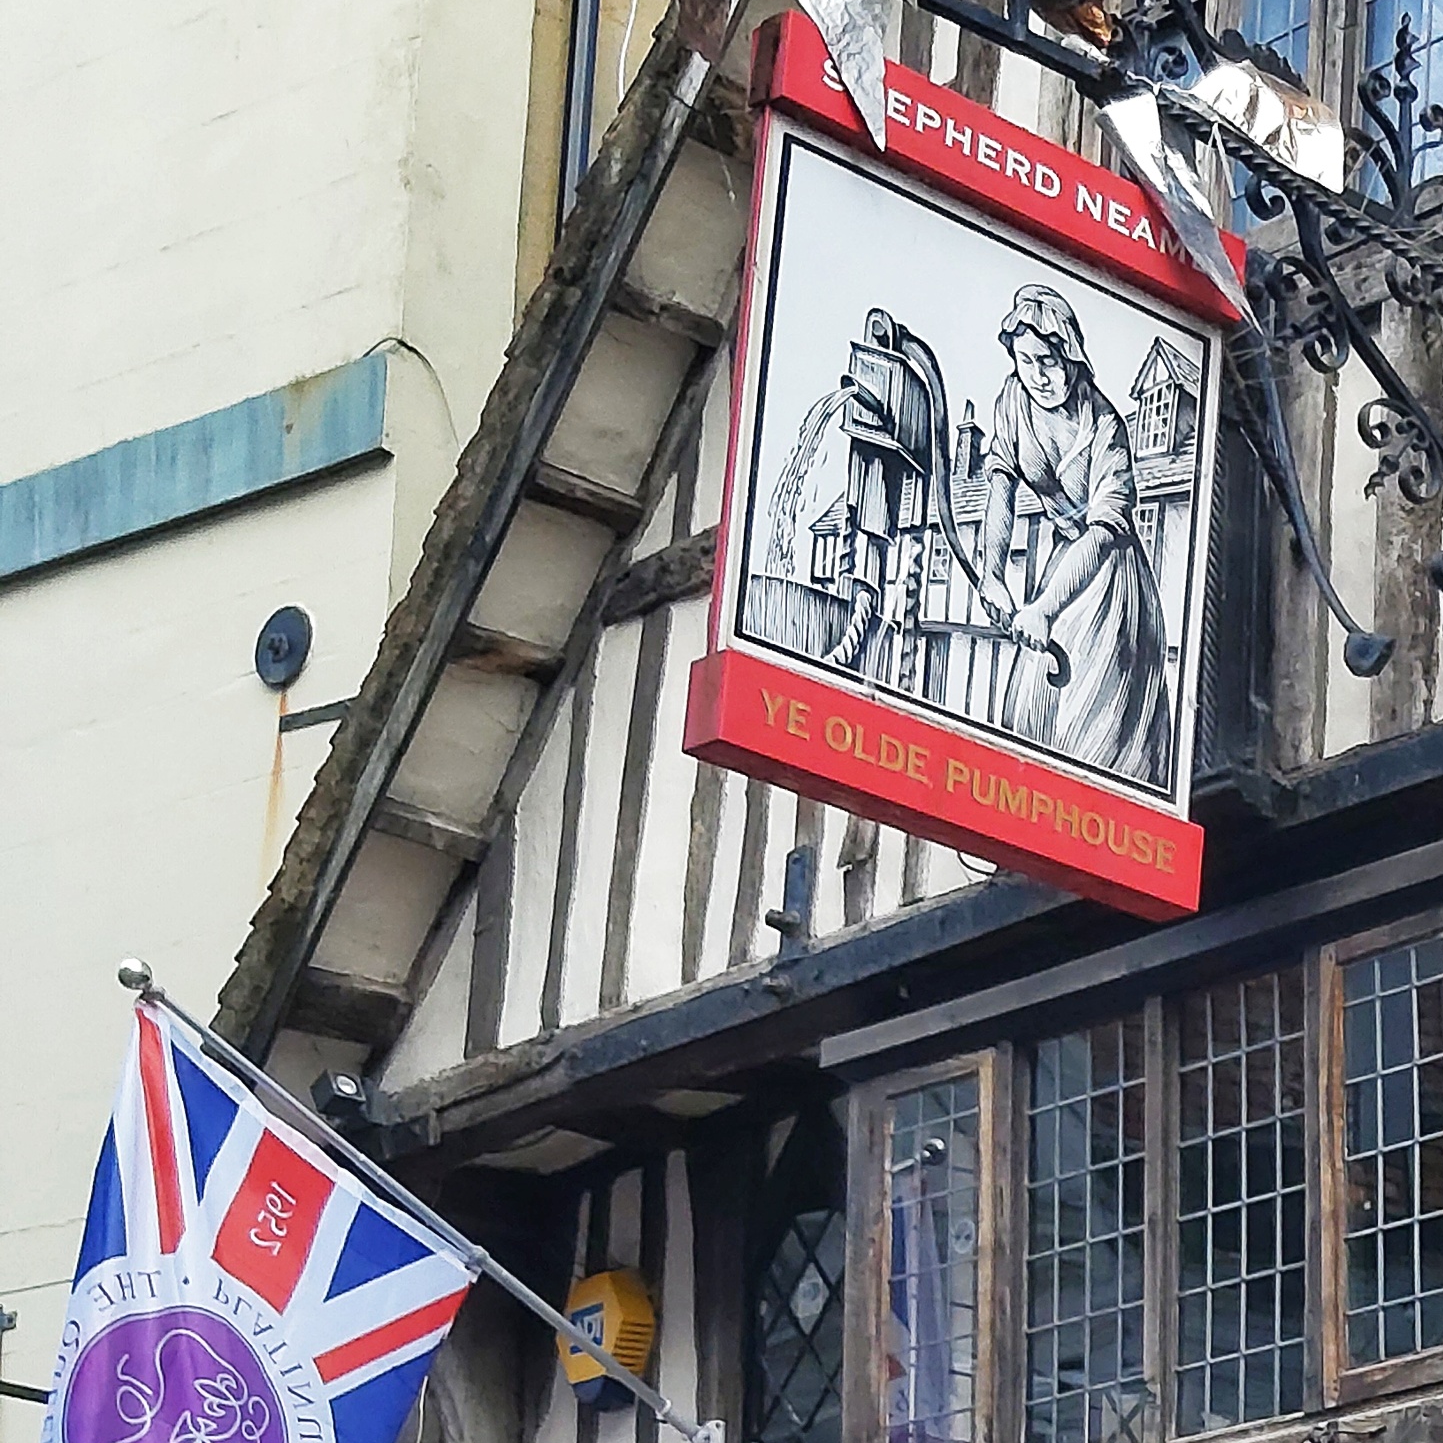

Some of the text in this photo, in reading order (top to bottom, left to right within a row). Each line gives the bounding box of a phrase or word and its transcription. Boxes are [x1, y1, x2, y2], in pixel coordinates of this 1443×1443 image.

[822, 58, 1061, 198] SEPHERD
[760, 687, 1177, 874] YE OLDE PUMPHOUSE
